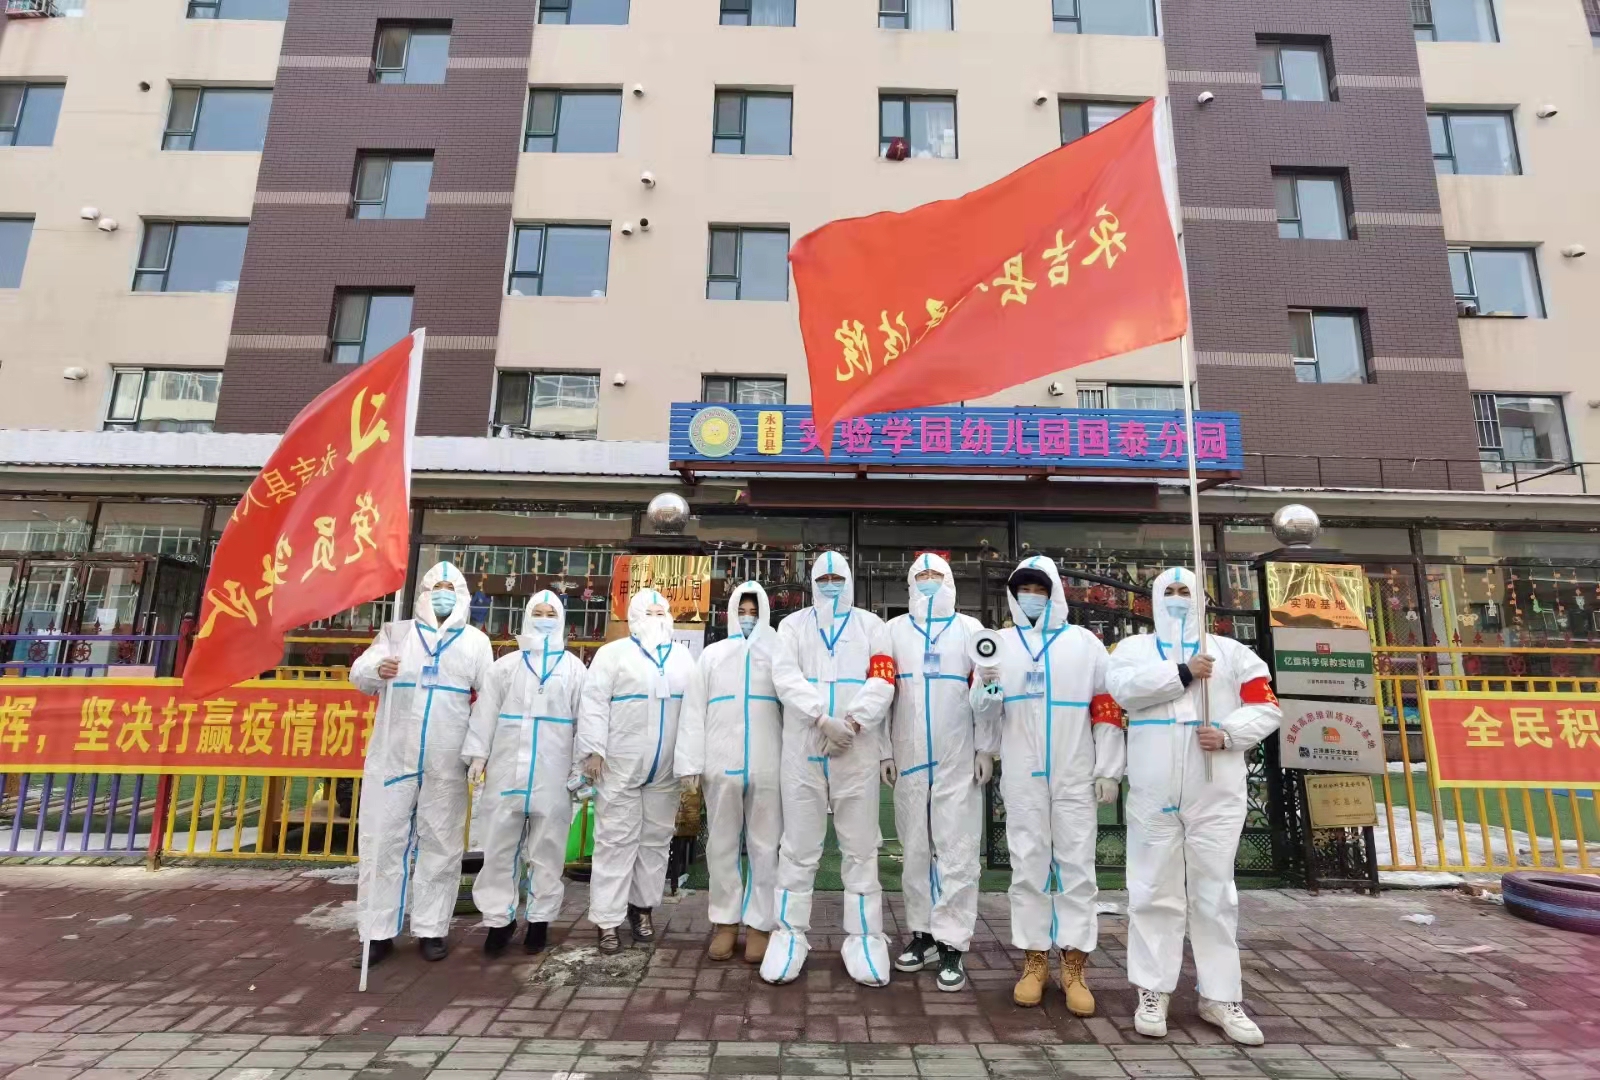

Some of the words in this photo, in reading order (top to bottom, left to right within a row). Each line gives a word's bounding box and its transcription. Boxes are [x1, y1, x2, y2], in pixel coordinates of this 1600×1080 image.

[764, 413, 777, 451] 永吉县
[800, 416, 1228, 460] 实验学园幼儿园国泰分园
[1290, 598, 1347, 611] 实验基地
[1284, 656, 1365, 669] 亿童科学保教实验园
[1462, 705, 1600, 750] 全民积
